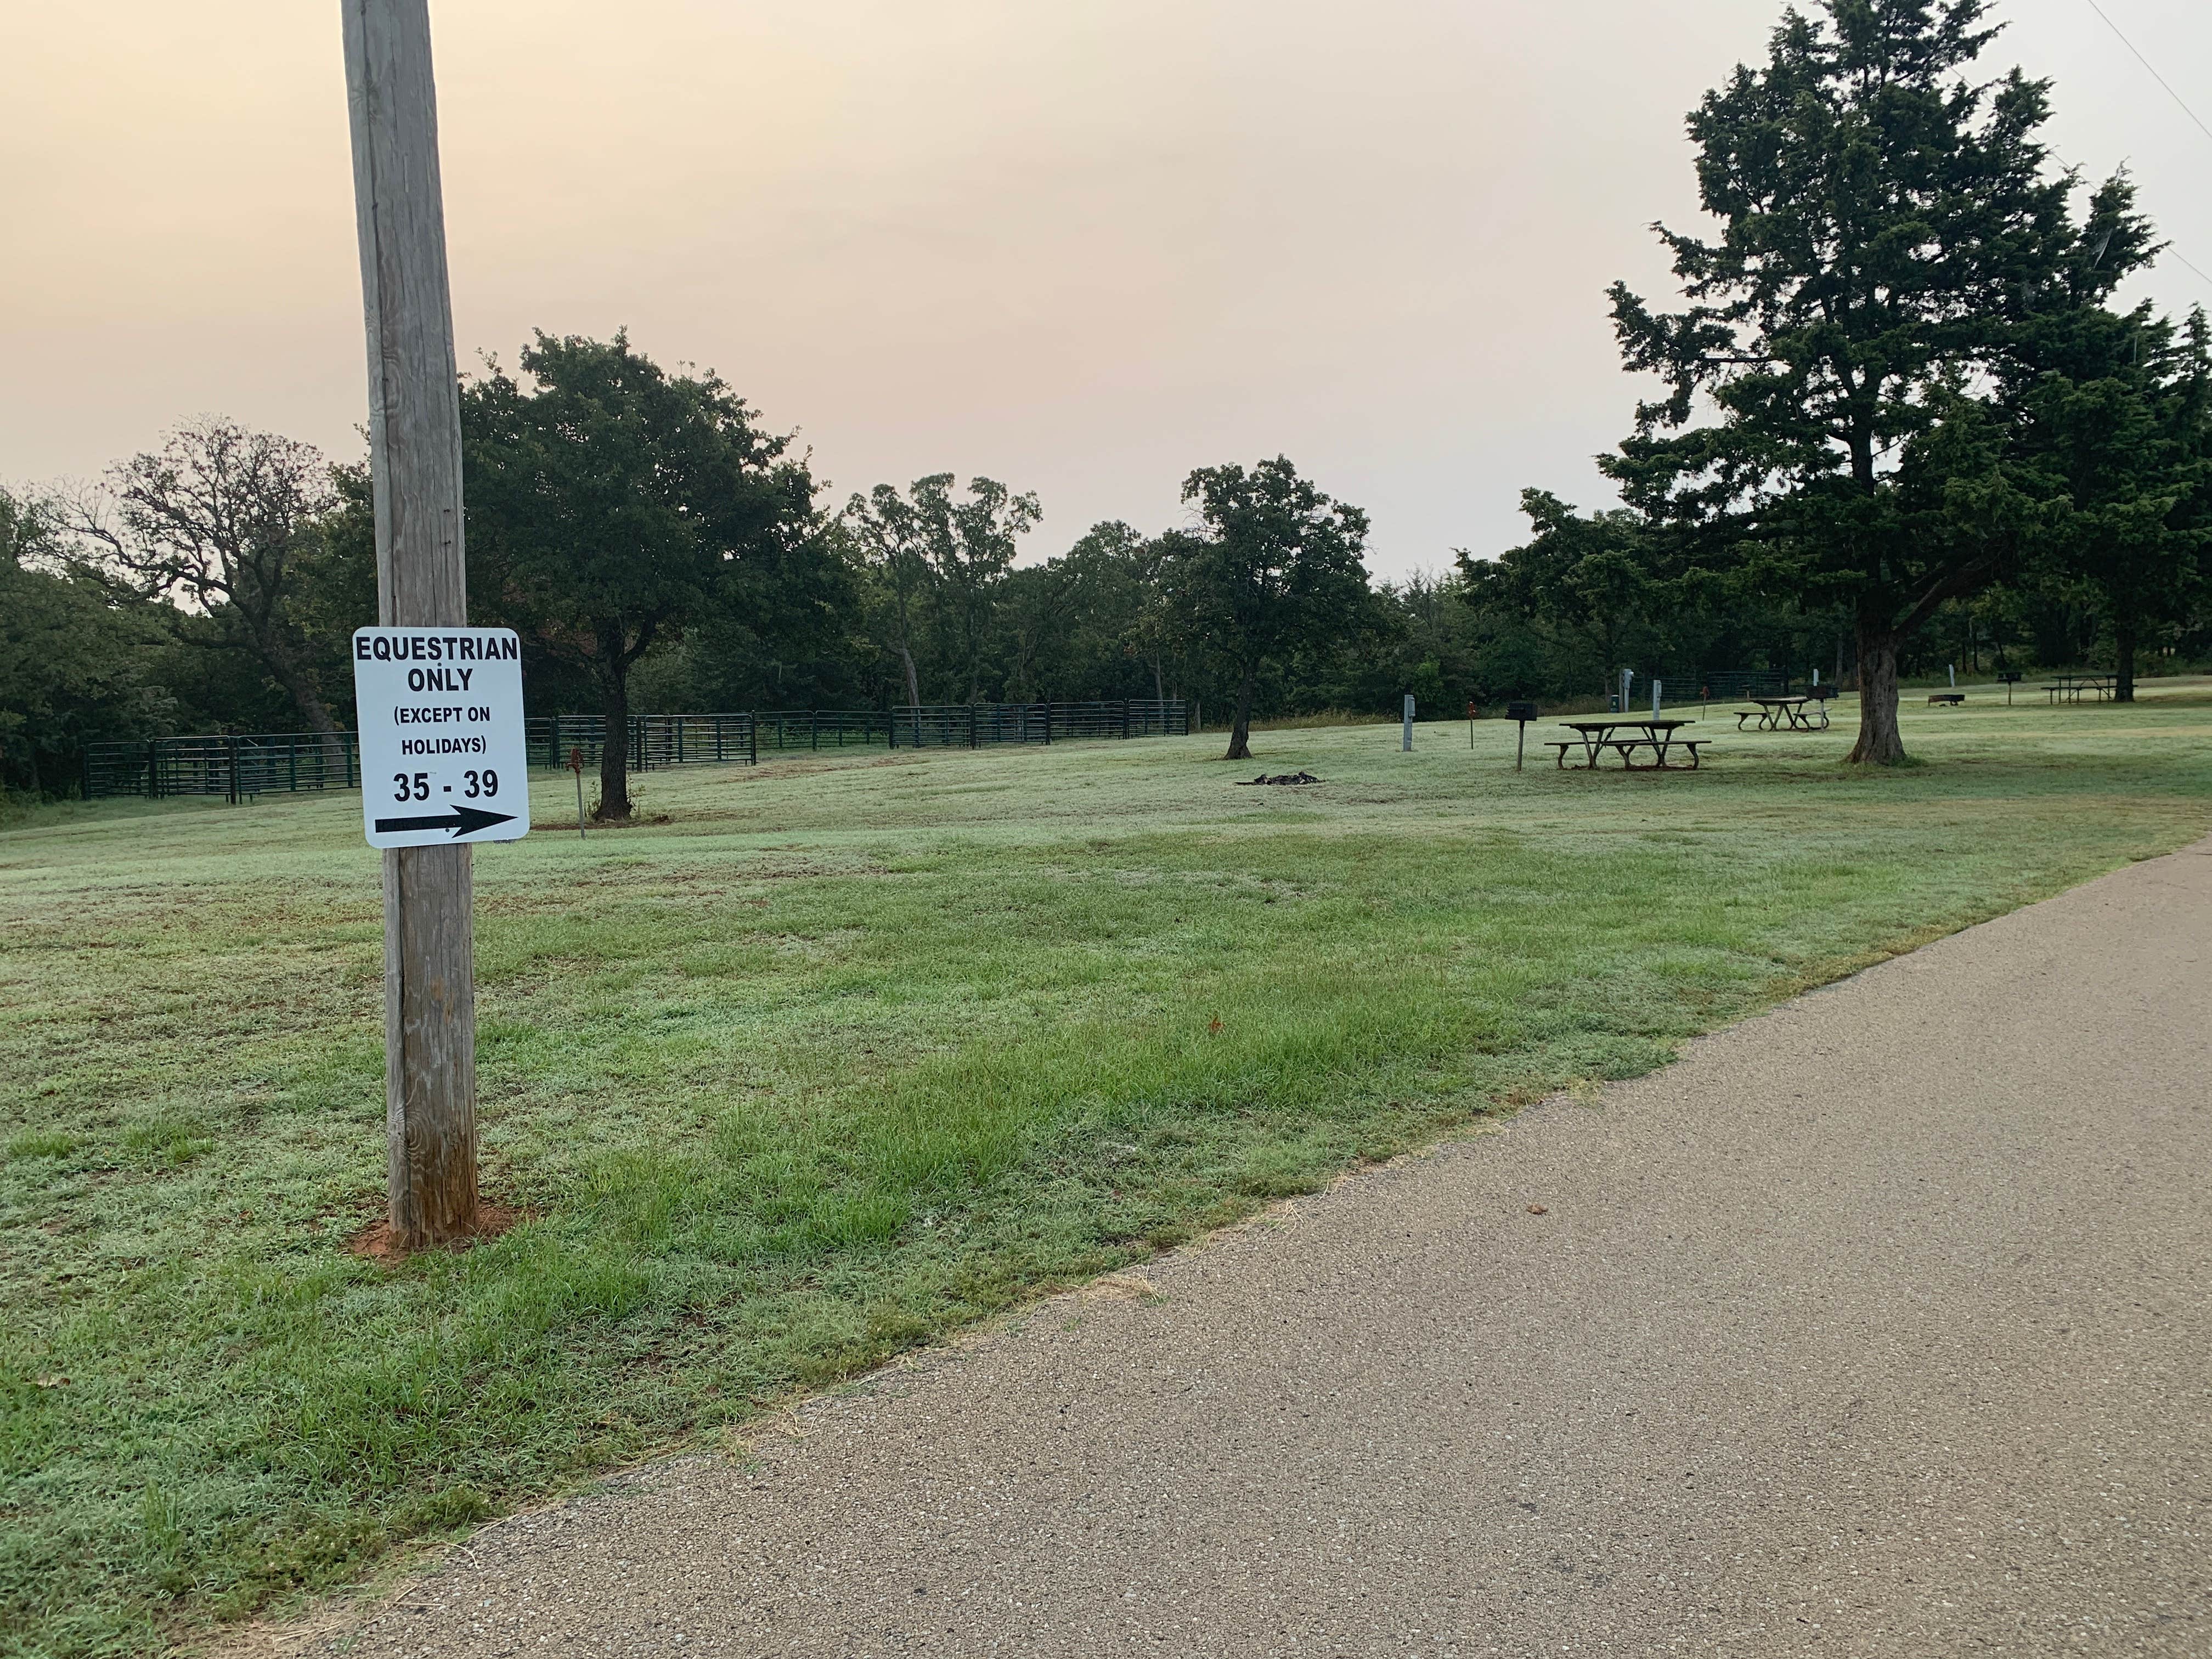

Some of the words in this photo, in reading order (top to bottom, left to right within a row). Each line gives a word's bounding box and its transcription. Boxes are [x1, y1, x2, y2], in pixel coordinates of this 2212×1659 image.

[356, 636, 517, 662] EQUESTRIAN
[408, 668, 473, 691] ONLY
[394, 706, 462, 725] (EXCEPT
[468, 707, 490, 721] ON
[402, 735, 487, 755] HOLIDAYS)
[393, 772, 430, 802] 35
[464, 770, 498, 798] 39
